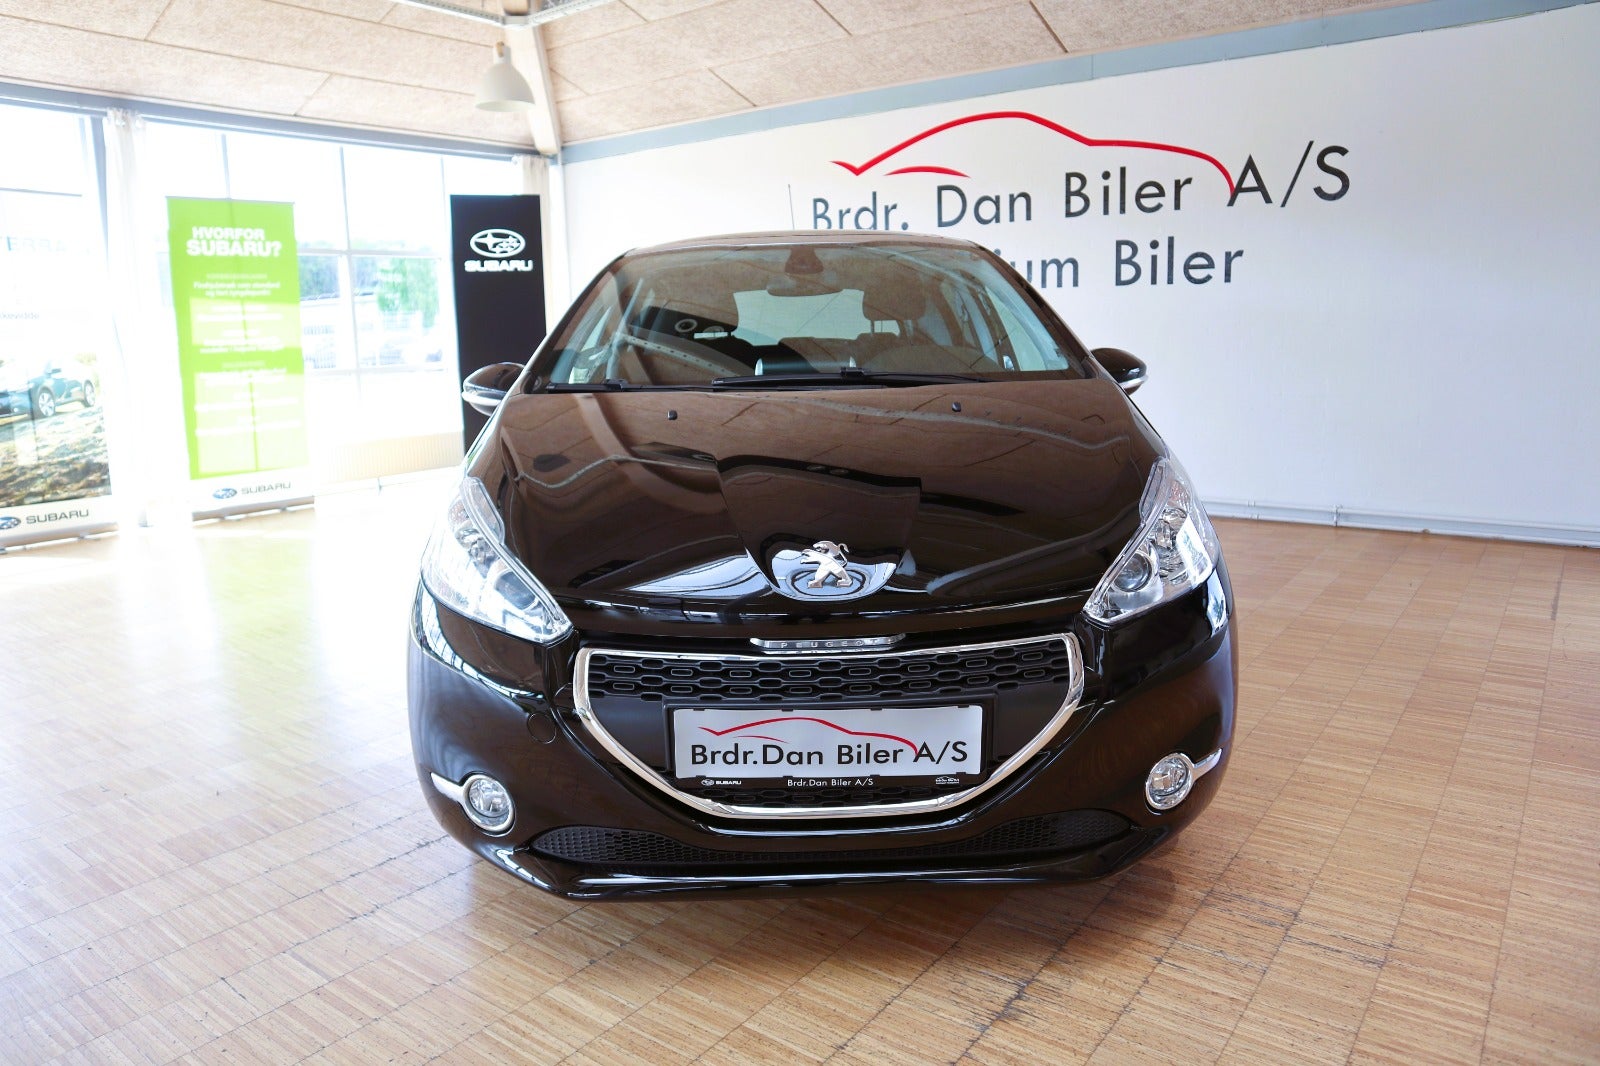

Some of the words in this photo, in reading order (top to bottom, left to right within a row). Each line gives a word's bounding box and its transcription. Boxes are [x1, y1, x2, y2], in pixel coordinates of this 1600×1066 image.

[812, 191, 909, 230] Brdr.
[936, 184, 1032, 229] Dan
[1064, 167, 1193, 217] Biler
[1227, 140, 1351, 208] A/S
[192, 227, 265, 240] HVORFOR
[187, 239, 282, 257] SUBARU?
[463, 259, 534, 272] SUBARU
[1115, 235, 1245, 288] Biler
[240, 481, 292, 495] SUBARU
[25, 508, 90, 525] SUBARU
[780, 639, 878, 648] PEUGEOT
[691, 742, 824, 766] Brdr.Dan
[836, 741, 904, 765] Biler
[912, 740, 969, 765] A/S
[787, 778, 828, 787] Brdr.Dan
[831, 778, 852, 786] Biler
[854, 777, 874, 787] A/S
